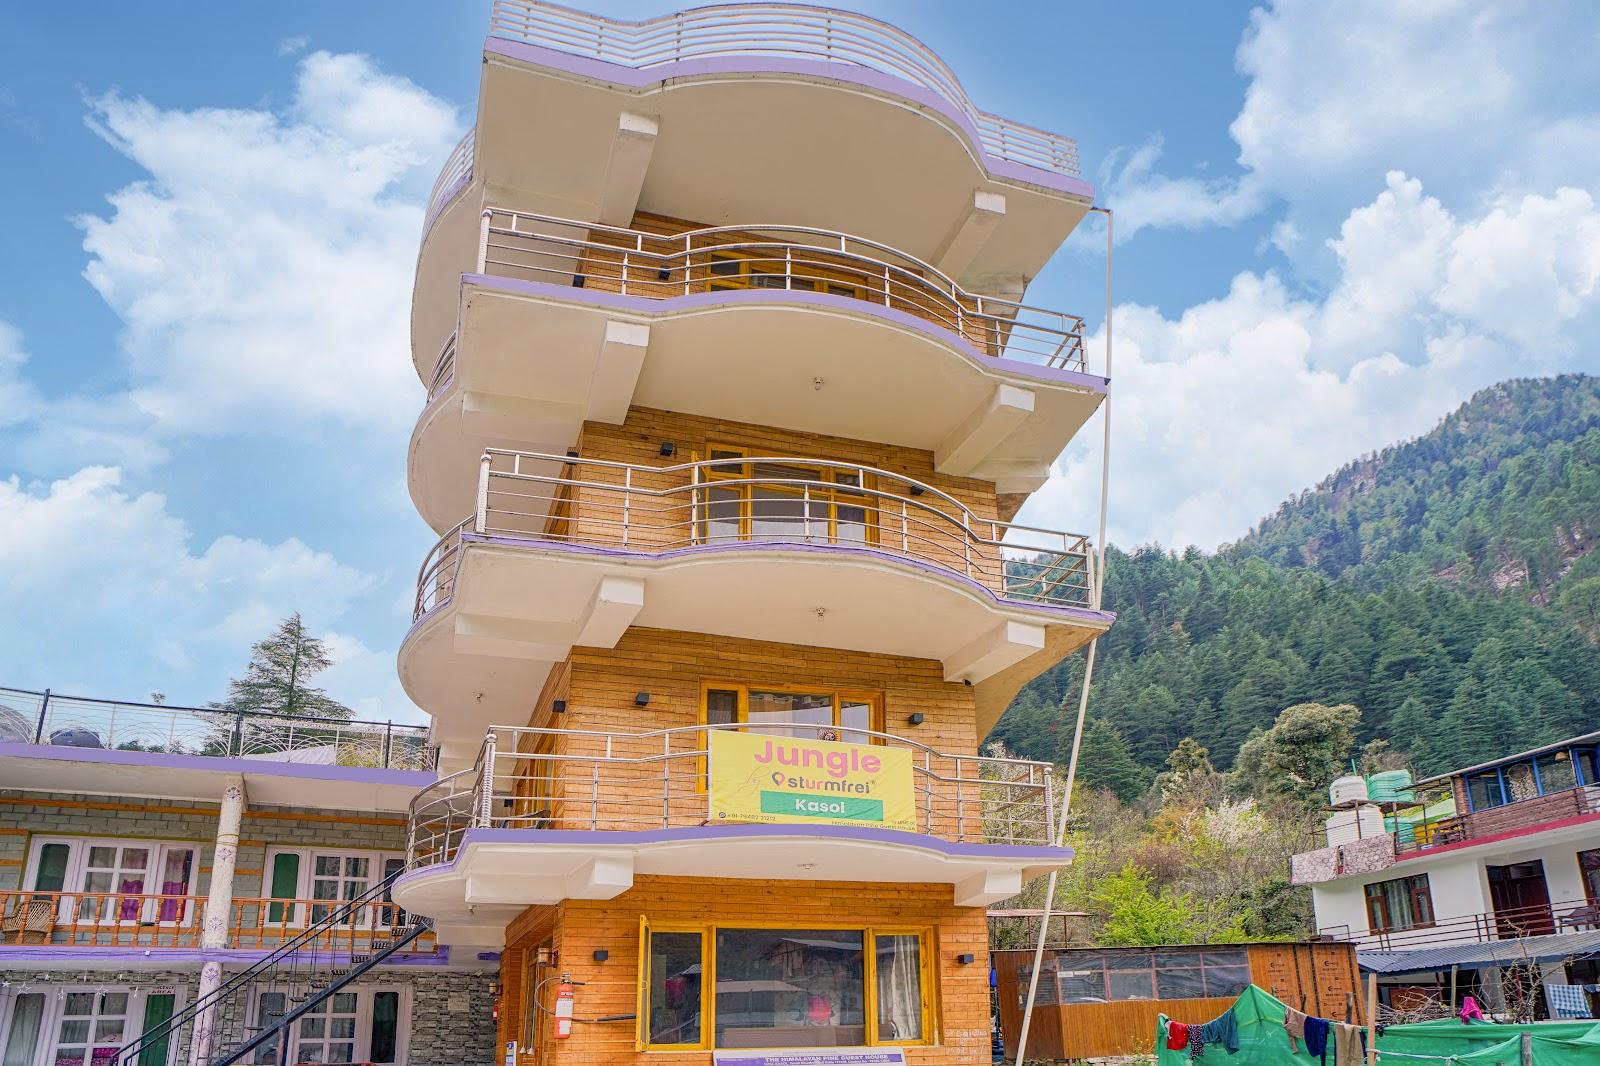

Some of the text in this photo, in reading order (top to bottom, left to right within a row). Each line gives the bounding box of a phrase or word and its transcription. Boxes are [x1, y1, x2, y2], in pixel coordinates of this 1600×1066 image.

[754, 740, 881, 778] Jungle
[787, 776, 871, 794] sturmfrei
[795, 798, 845, 814] Kasol
